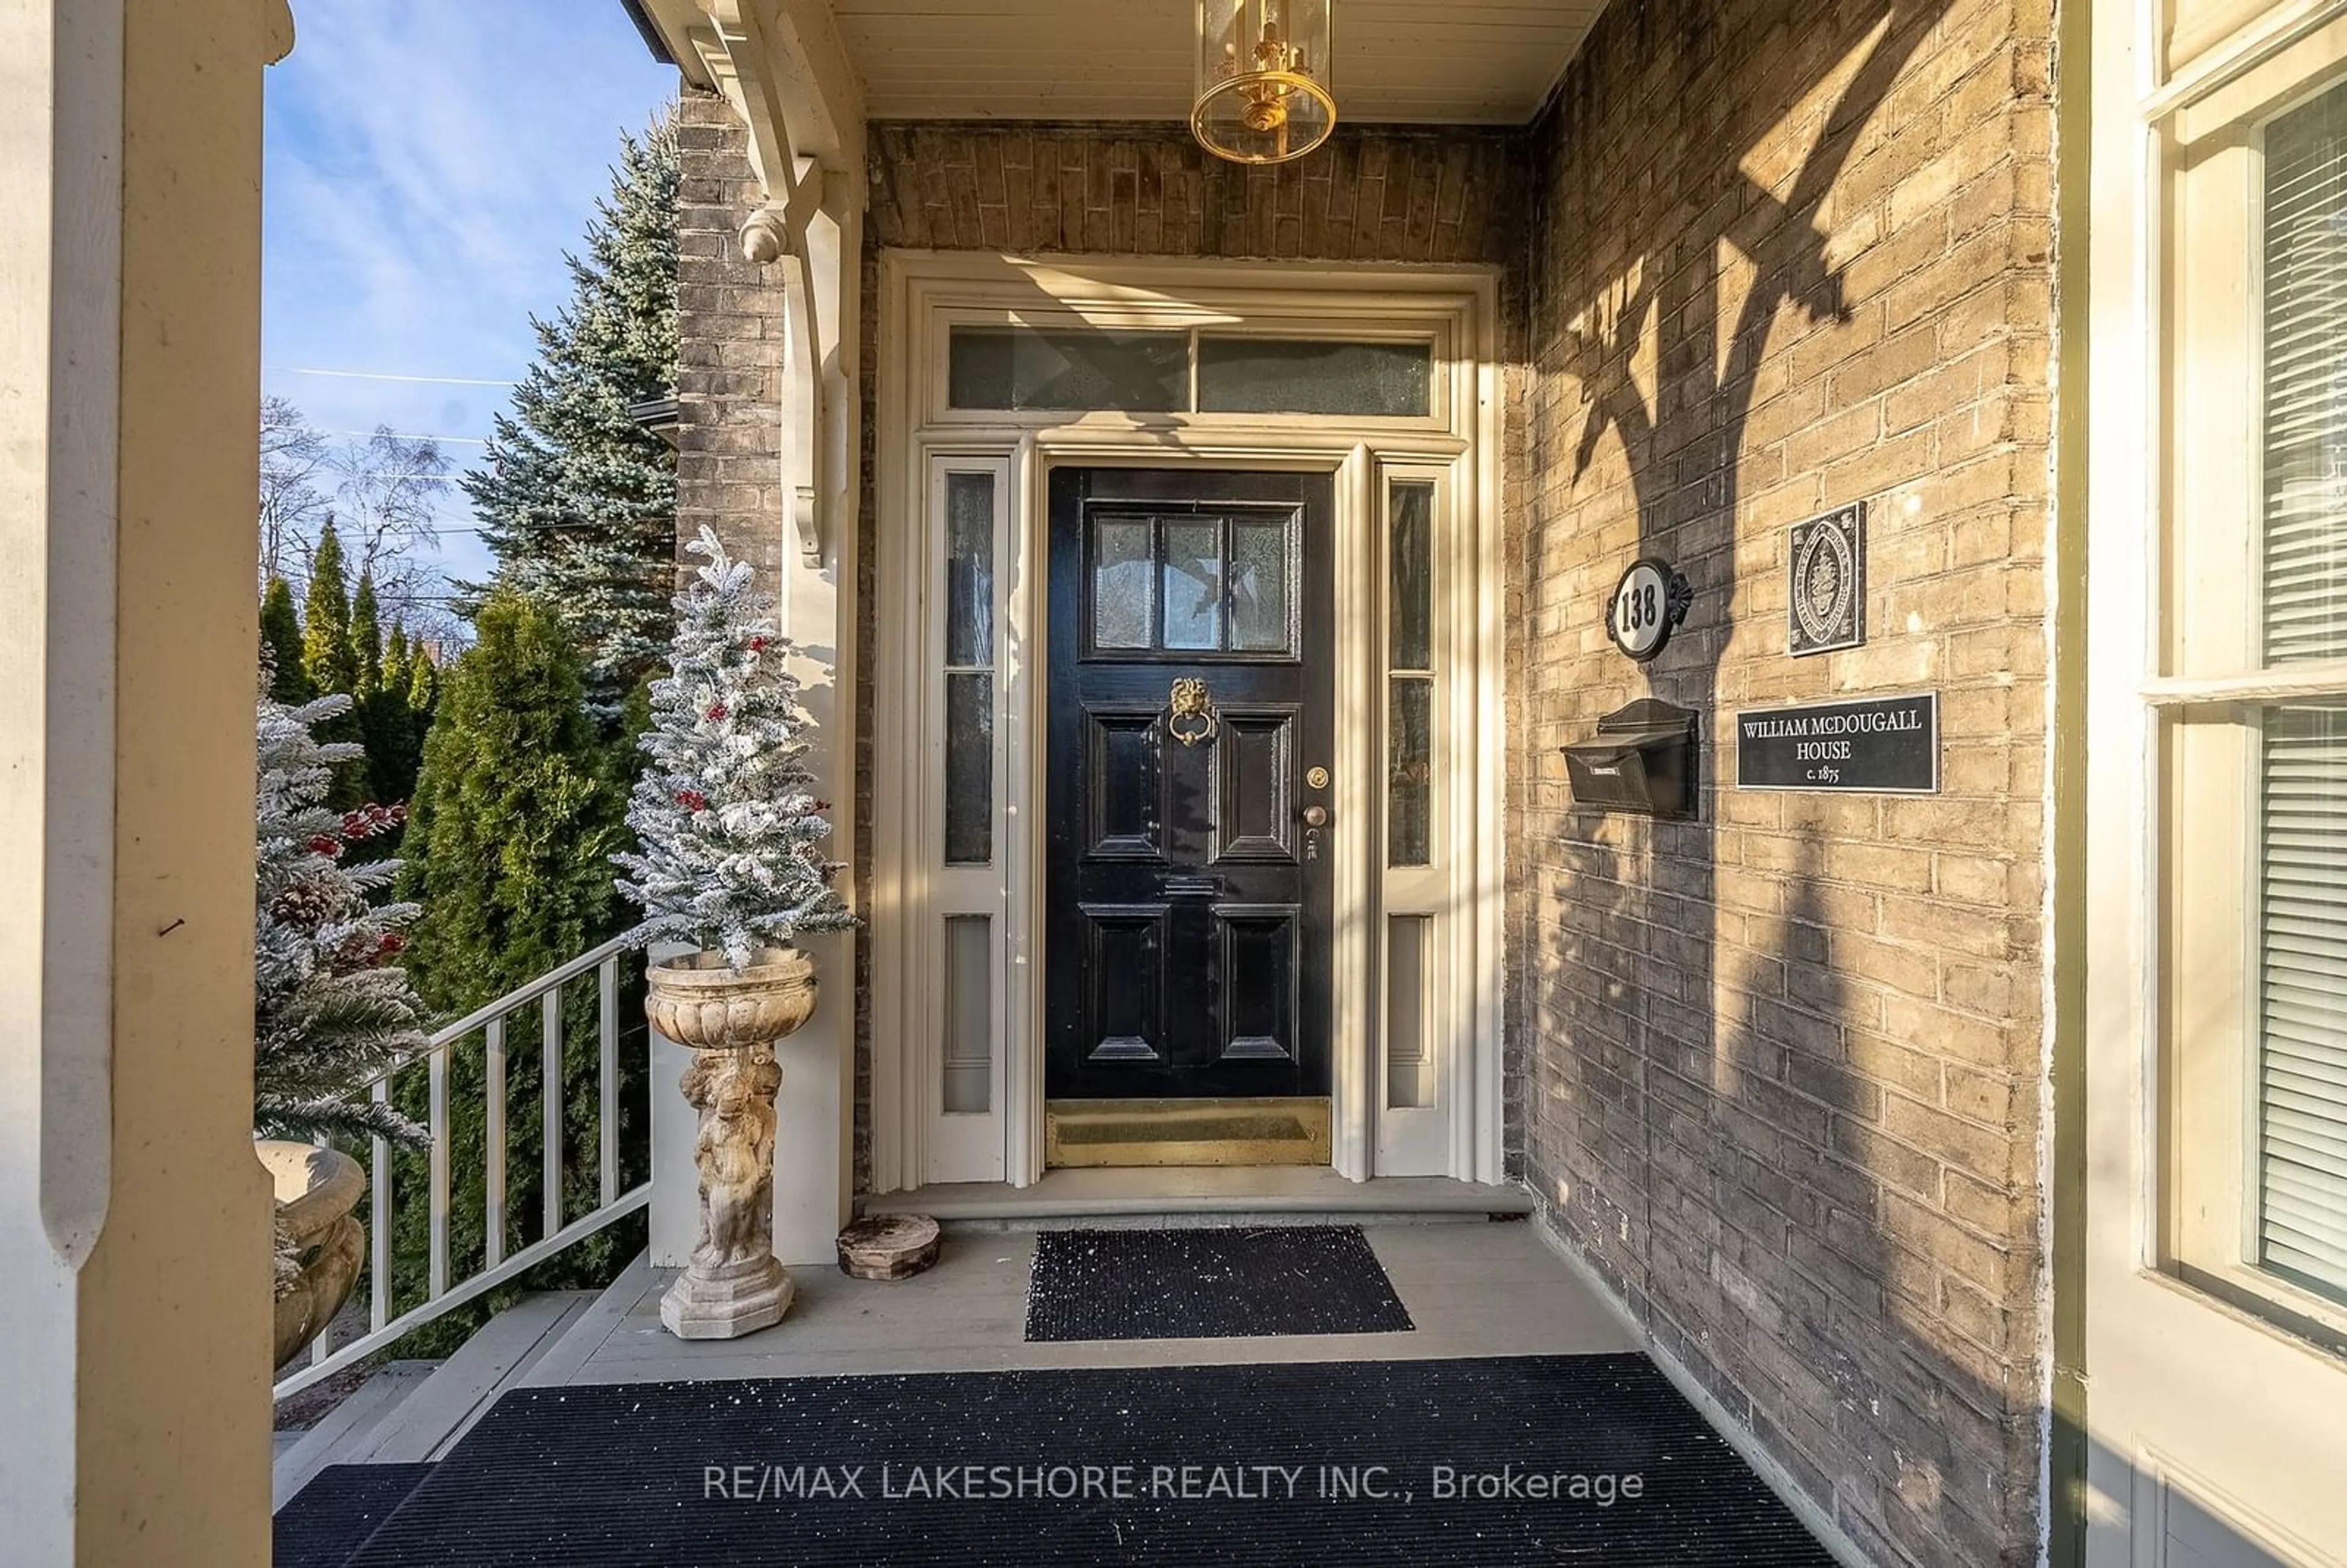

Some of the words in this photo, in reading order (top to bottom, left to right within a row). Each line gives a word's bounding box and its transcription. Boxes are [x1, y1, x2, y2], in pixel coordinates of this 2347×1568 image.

[1622, 584, 1656, 633] 138
[1744, 718, 1808, 738] WILLIAM
[1796, 741, 1853, 760] HOUSE
[1806, 768, 1816, 780] c.
[1818, 765, 1840, 783] 1875
